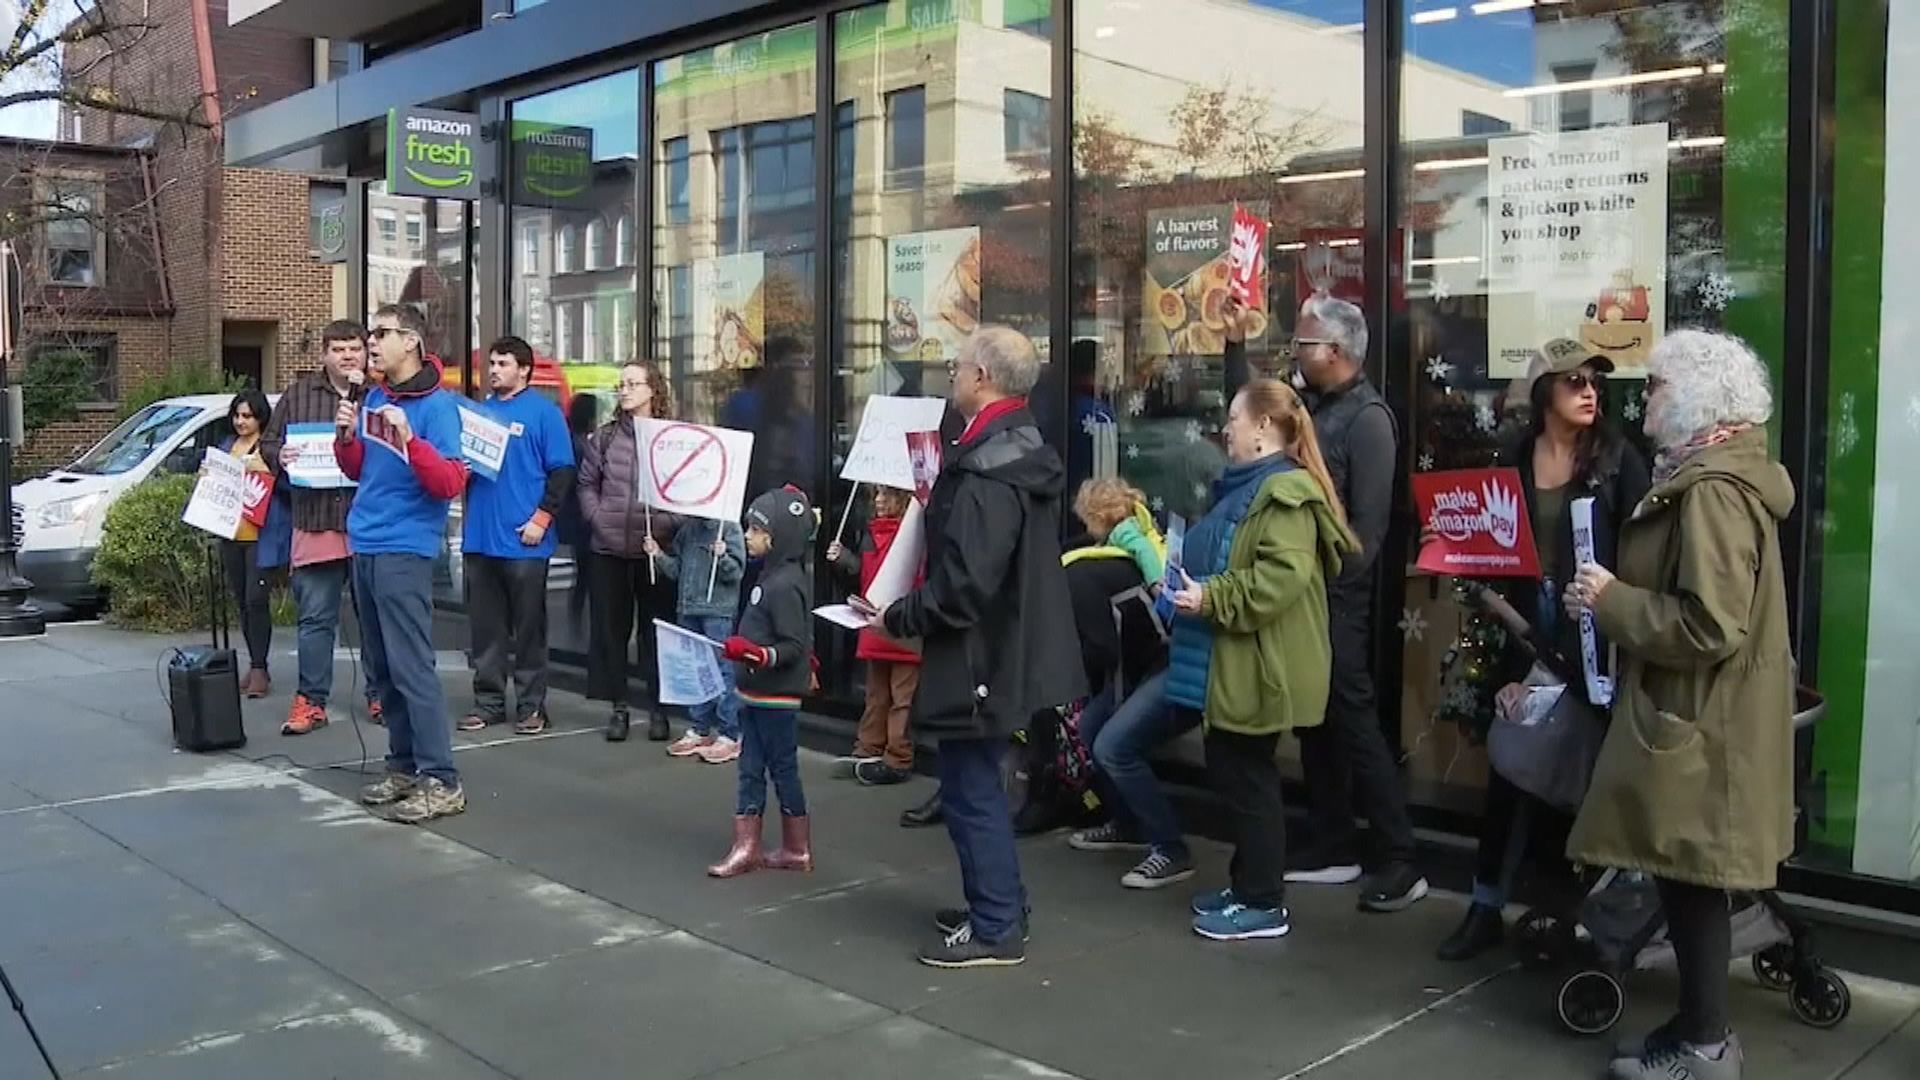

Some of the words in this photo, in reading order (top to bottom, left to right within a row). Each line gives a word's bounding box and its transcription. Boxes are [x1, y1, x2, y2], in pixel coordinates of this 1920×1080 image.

[407, 116, 471, 136] amazon
[406, 134, 471, 166] fresh
[1579, 171, 1649, 187] returns
[1502, 202, 1514, 217] &
[1518, 200, 1580, 219] pickup
[1156, 221, 1166, 234] A
[1169, 216, 1219, 233] harvest
[1502, 228, 1534, 244] you
[1537, 224, 1581, 241] shop
[894, 244, 924, 257] Savor
[1156, 238, 1169, 253] of
[1172, 236, 1219, 251] flavors
[1433, 485, 1479, 508] make
[1430, 513, 1488, 532] amazon
[1491, 514, 1514, 539] pay
